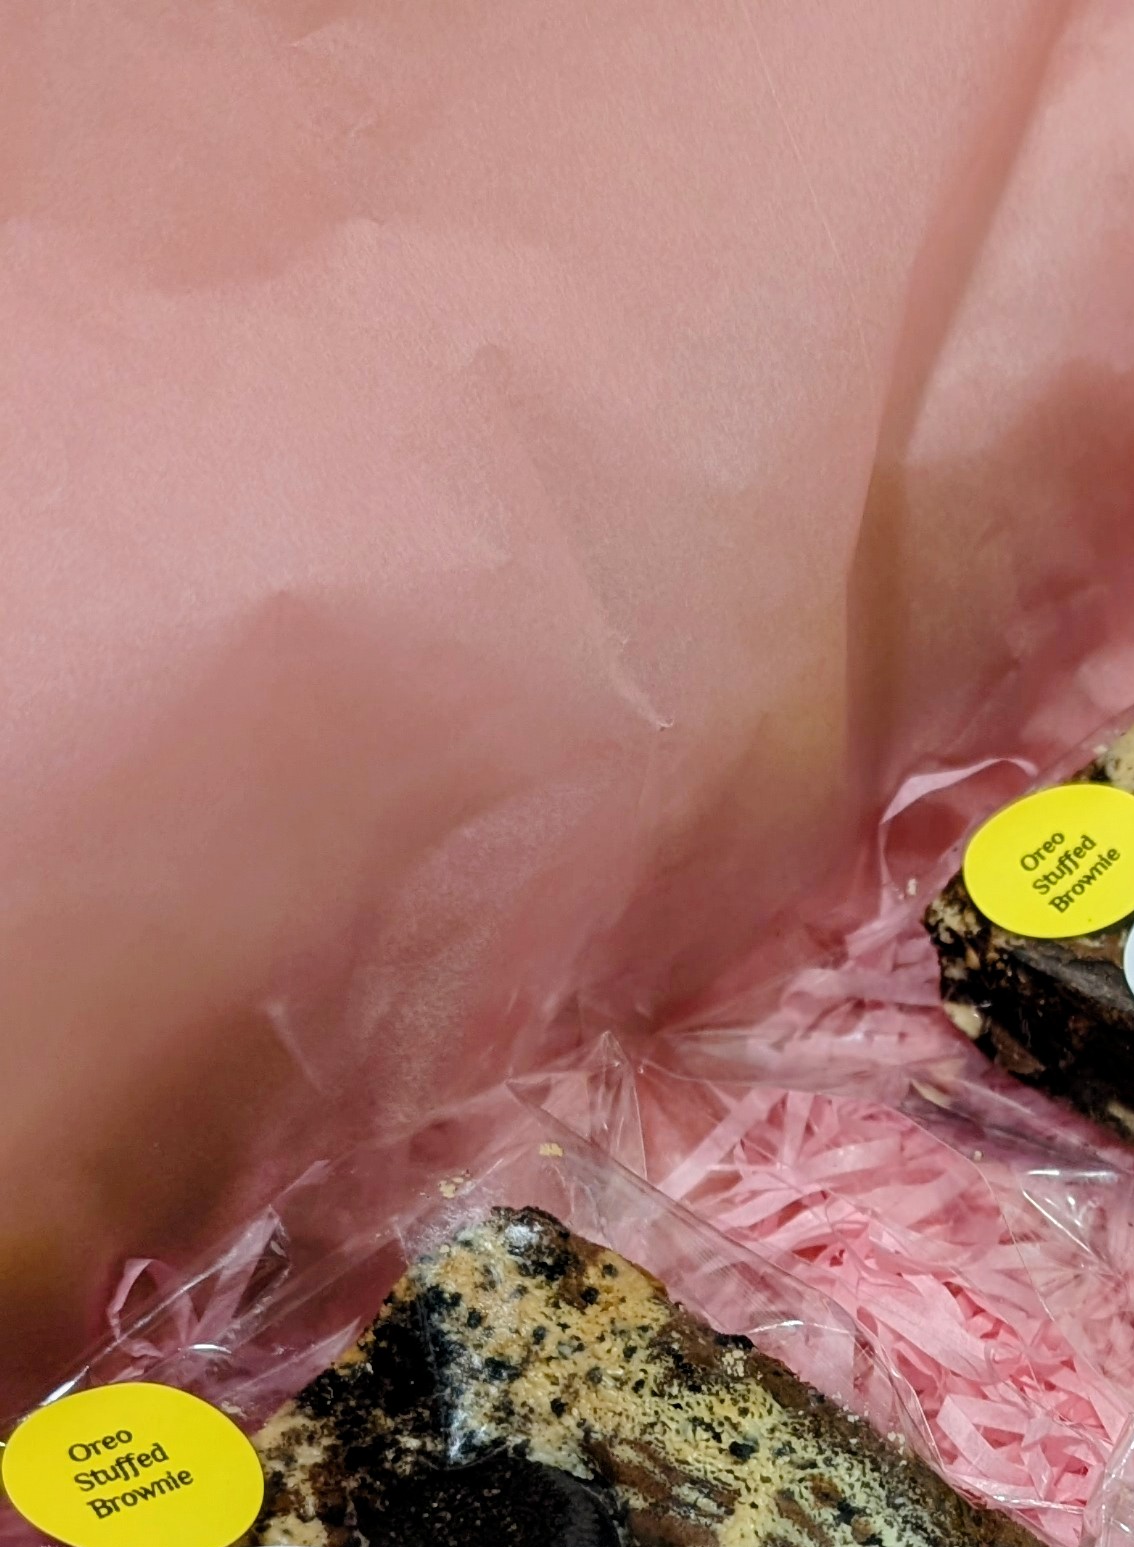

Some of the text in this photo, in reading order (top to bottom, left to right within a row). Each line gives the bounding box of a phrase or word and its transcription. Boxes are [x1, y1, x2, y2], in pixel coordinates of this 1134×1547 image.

[1021, 831, 1065, 873] Oreo
[1032, 834, 1097, 895] Stuffed
[1048, 846, 1121, 914] Brownie
[68, 1429, 133, 1463] Oreo
[74, 1443, 169, 1493] Stuffed
[87, 1467, 194, 1520] Brownie
